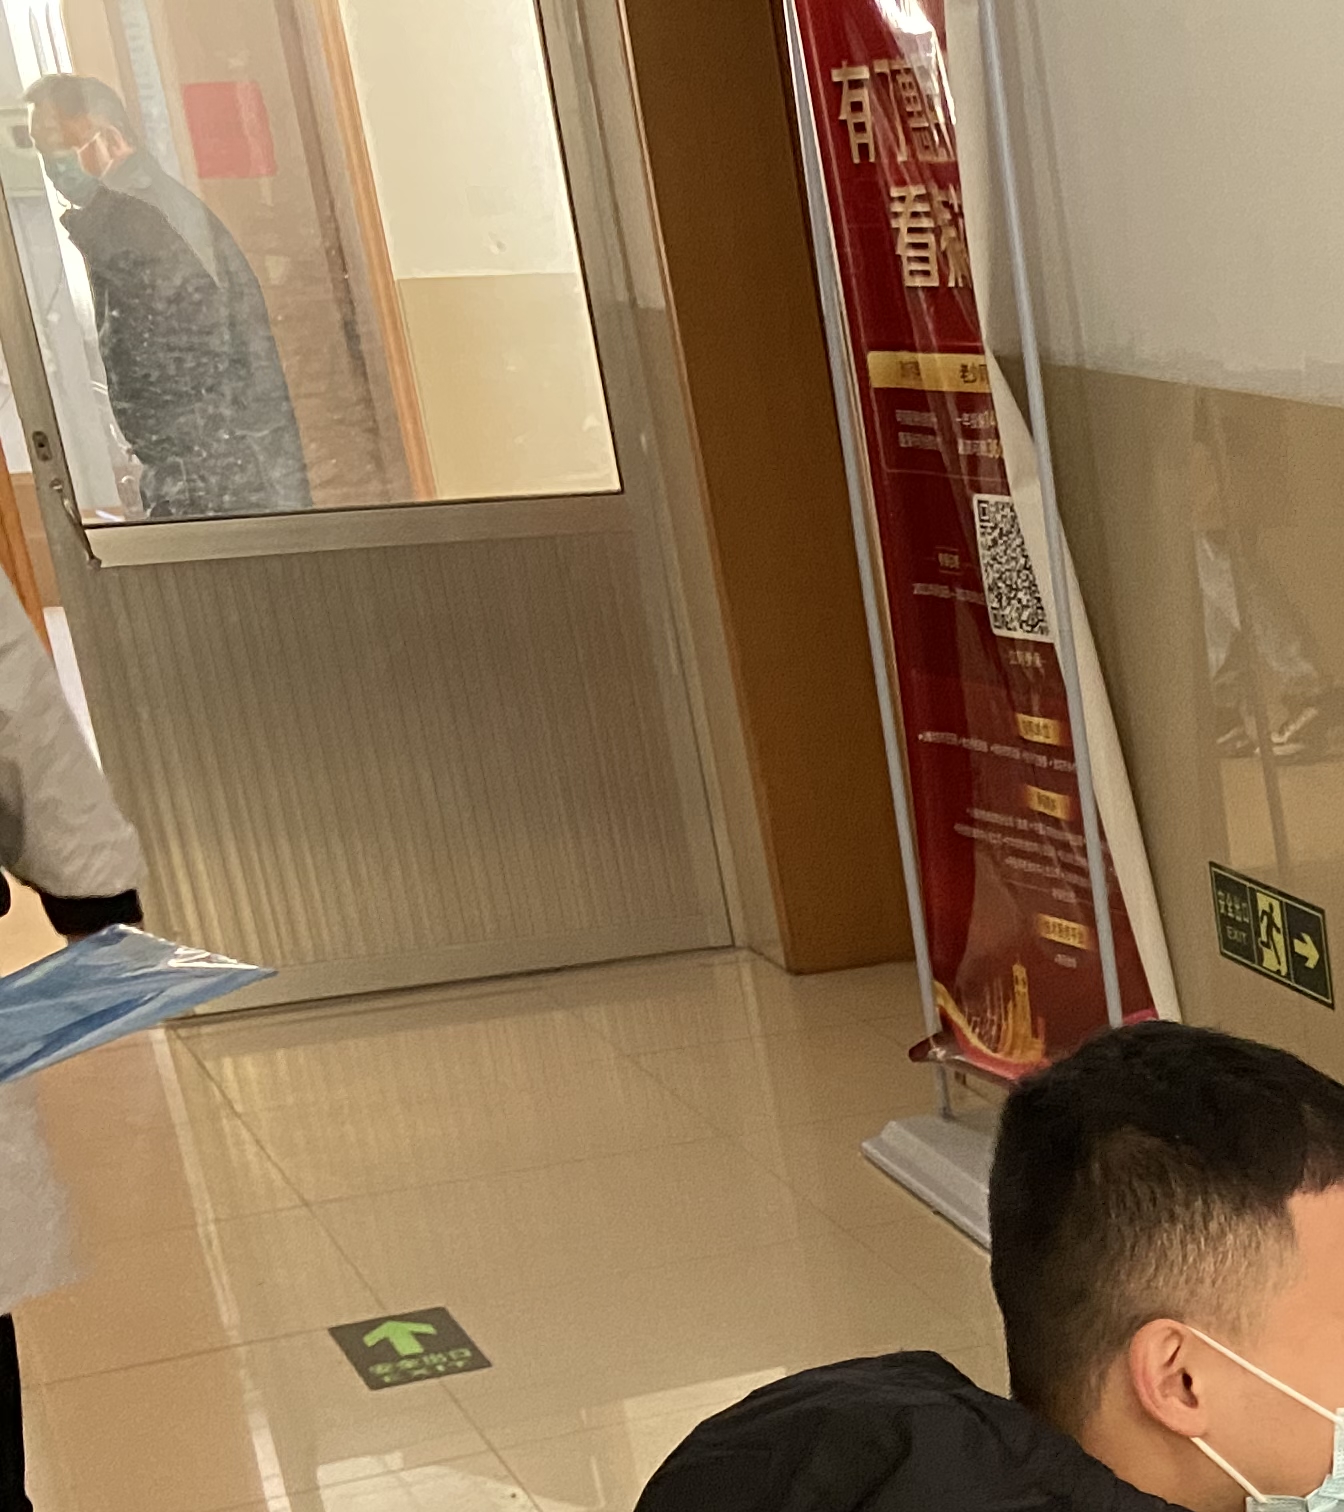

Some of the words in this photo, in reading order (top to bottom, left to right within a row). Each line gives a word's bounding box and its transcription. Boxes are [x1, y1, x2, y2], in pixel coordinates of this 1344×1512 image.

[1217, 890, 1250, 923] 安全出口
[1226, 926, 1248, 944] EXIT
